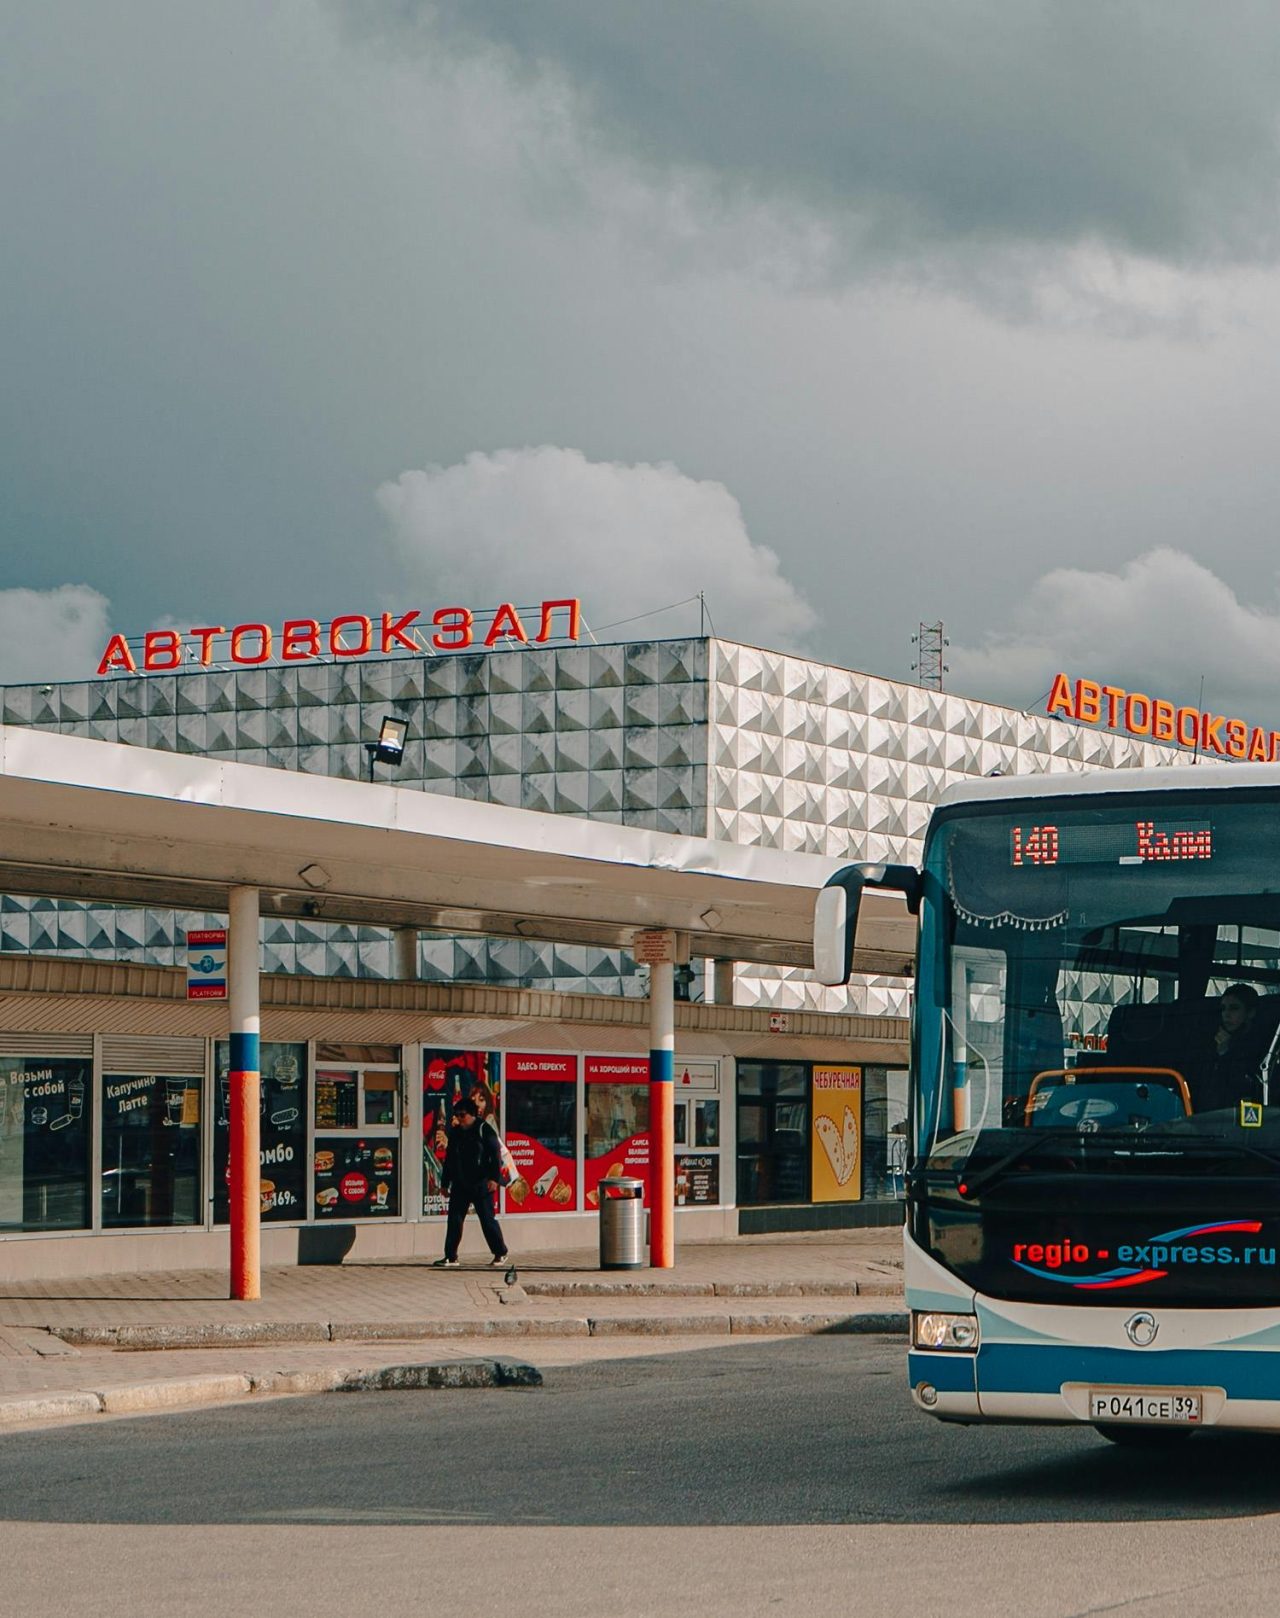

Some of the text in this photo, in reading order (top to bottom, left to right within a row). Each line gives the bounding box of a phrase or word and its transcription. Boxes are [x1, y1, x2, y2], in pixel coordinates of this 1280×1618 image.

[98, 598, 581, 676] АВТОВОКЗАЛ
[1013, 826, 1058, 865] 140
[189, 931, 225, 940] ПЛАТФОРМА
[517, 1061, 566, 1072] ЗДЕСЬ ПЕРЕКУС
[589, 1066, 599, 1074] НА
[599, 1065, 630, 1075] ХОРОШИЙ
[10, 1069, 53, 1085] Возьми
[814, 1071, 860, 1089] ЧЕБУРЕЧНАЯ
[24, 1080, 65, 1099] с собой
[106, 1076, 156, 1099] Капучино
[118, 1095, 148, 1114] Латте
[259, 1144, 294, 1165] омбо
